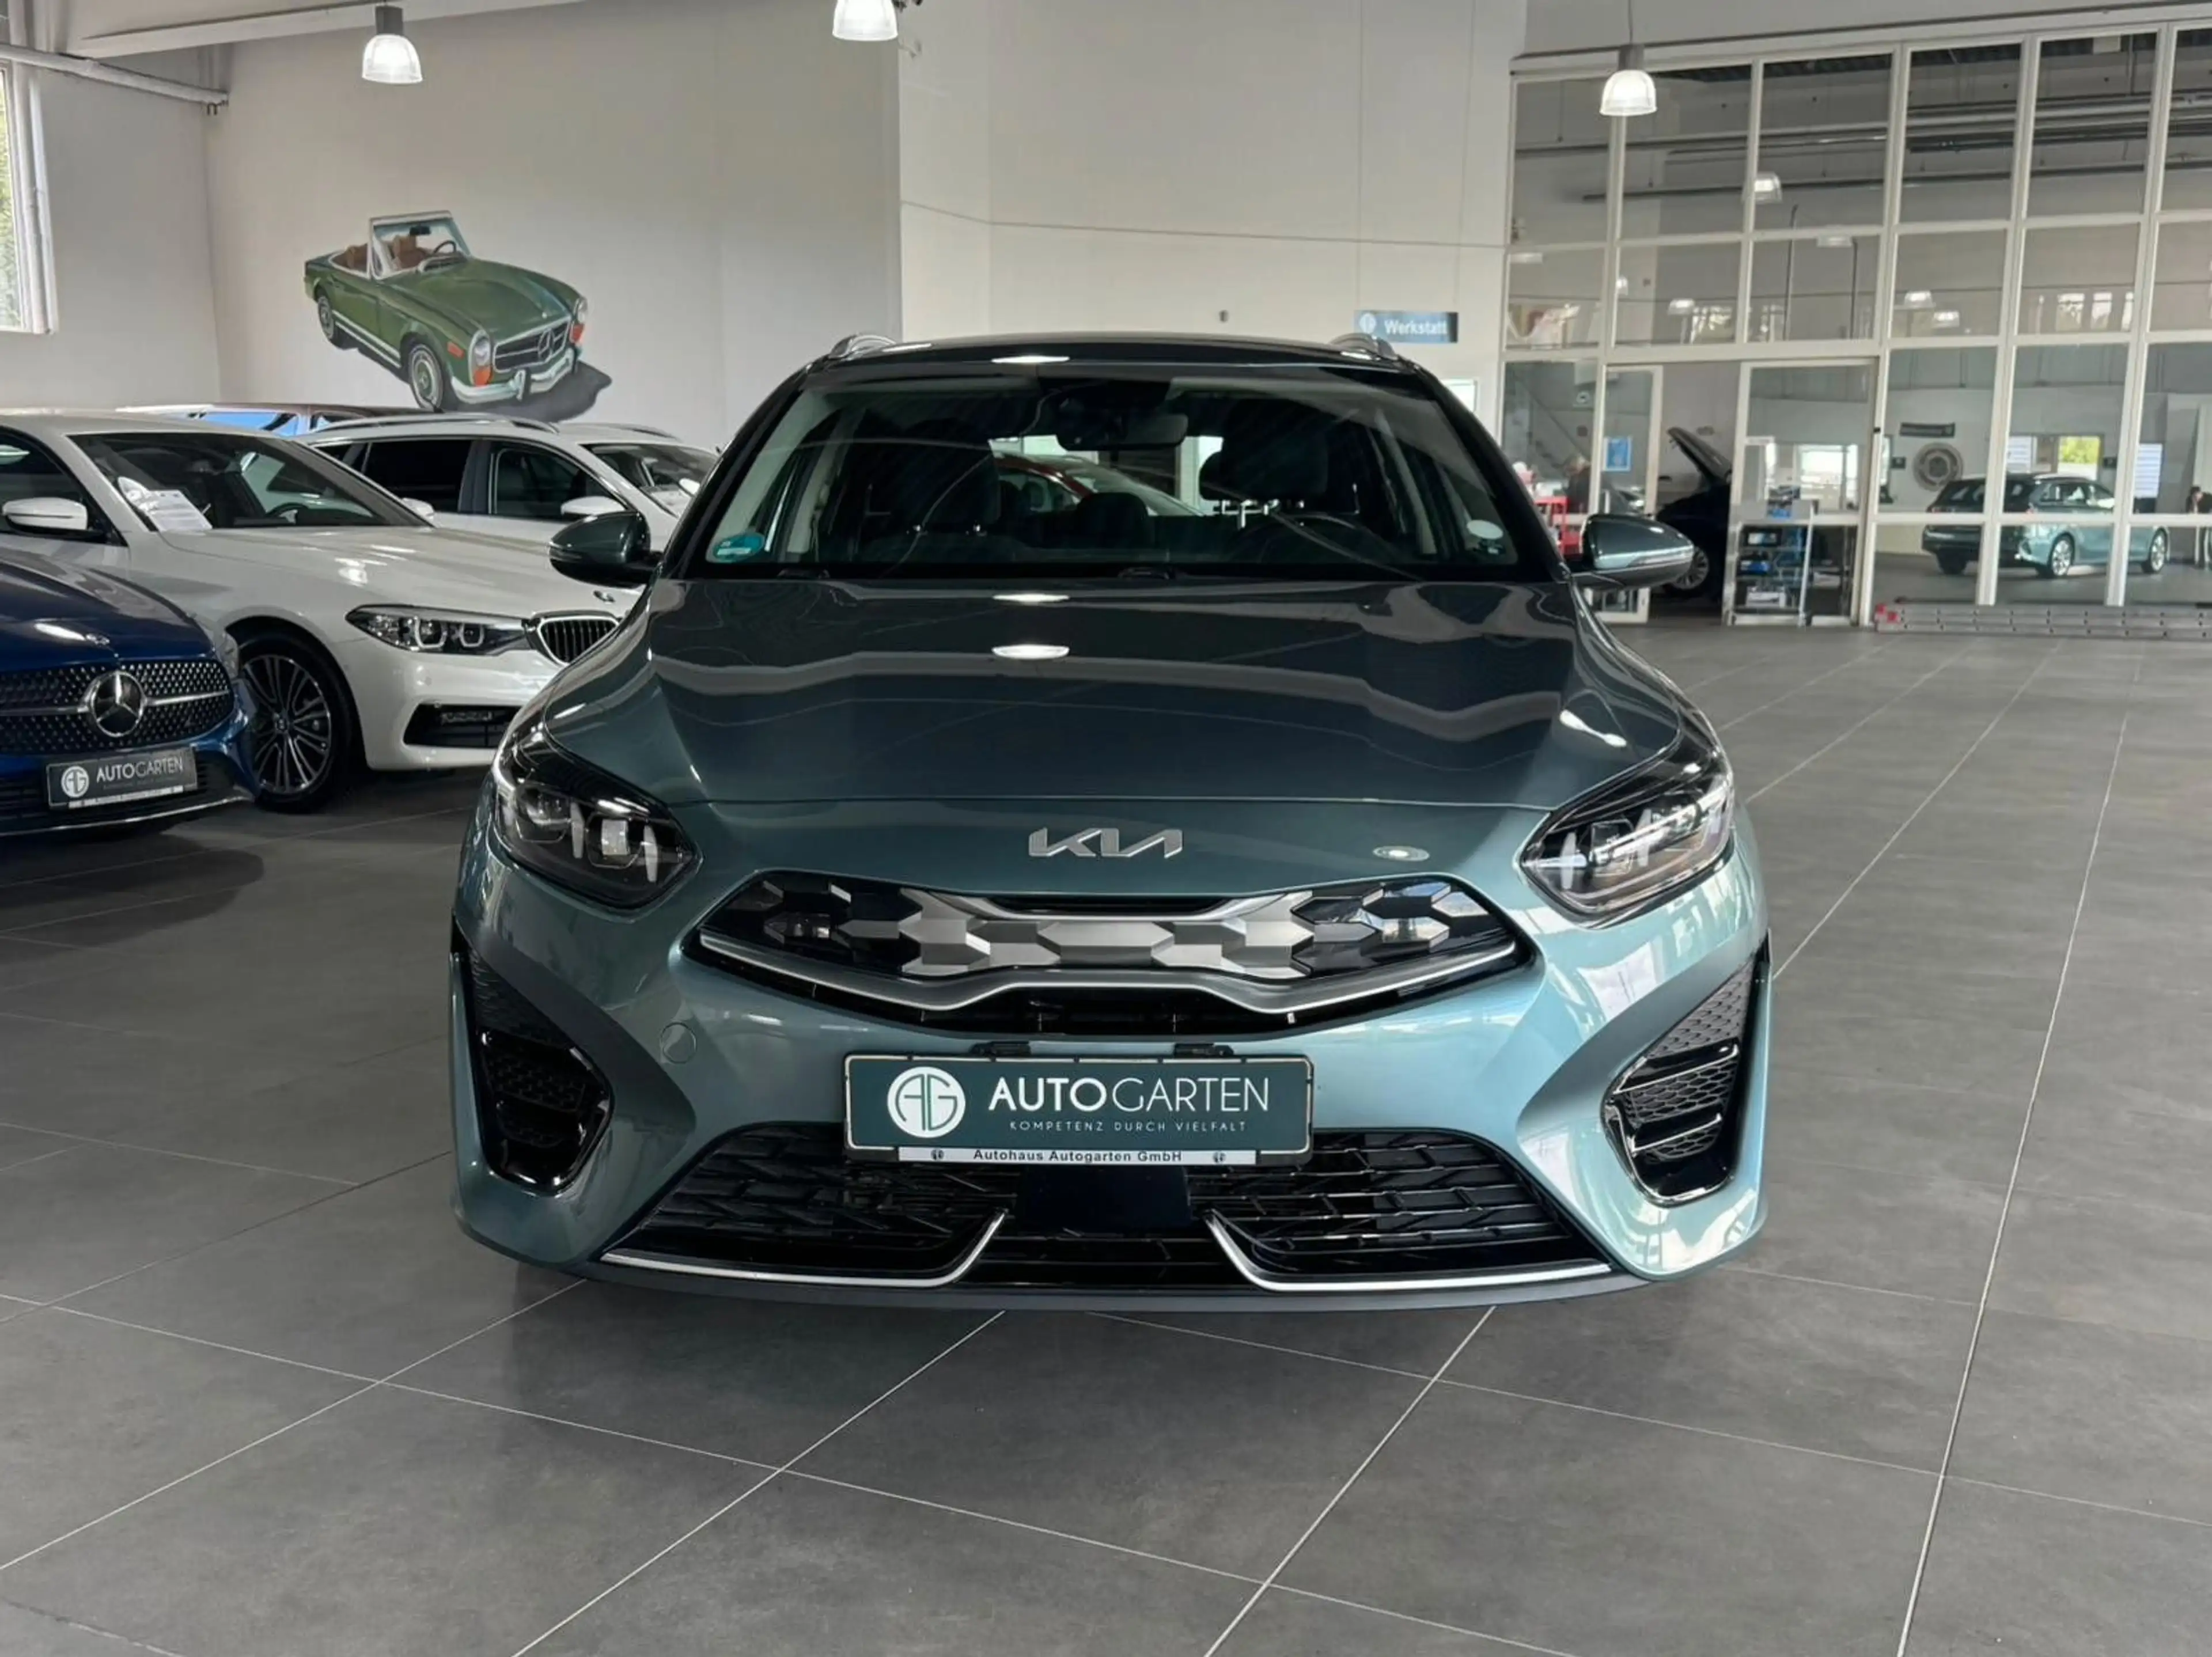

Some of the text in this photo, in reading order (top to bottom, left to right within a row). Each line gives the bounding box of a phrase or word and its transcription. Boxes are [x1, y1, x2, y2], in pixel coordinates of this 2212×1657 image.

[1384, 320, 1448, 335] Werkstatt
[96, 757, 183, 783] AUTOGARTEN
[988, 1076, 1269, 1112] AUTOGARTEN
[1010, 1121, 1246, 1132] KOMPETENZ DURCH VIELFALT
[974, 1149, 1181, 1163] Autohaus Autogarten GmbH
